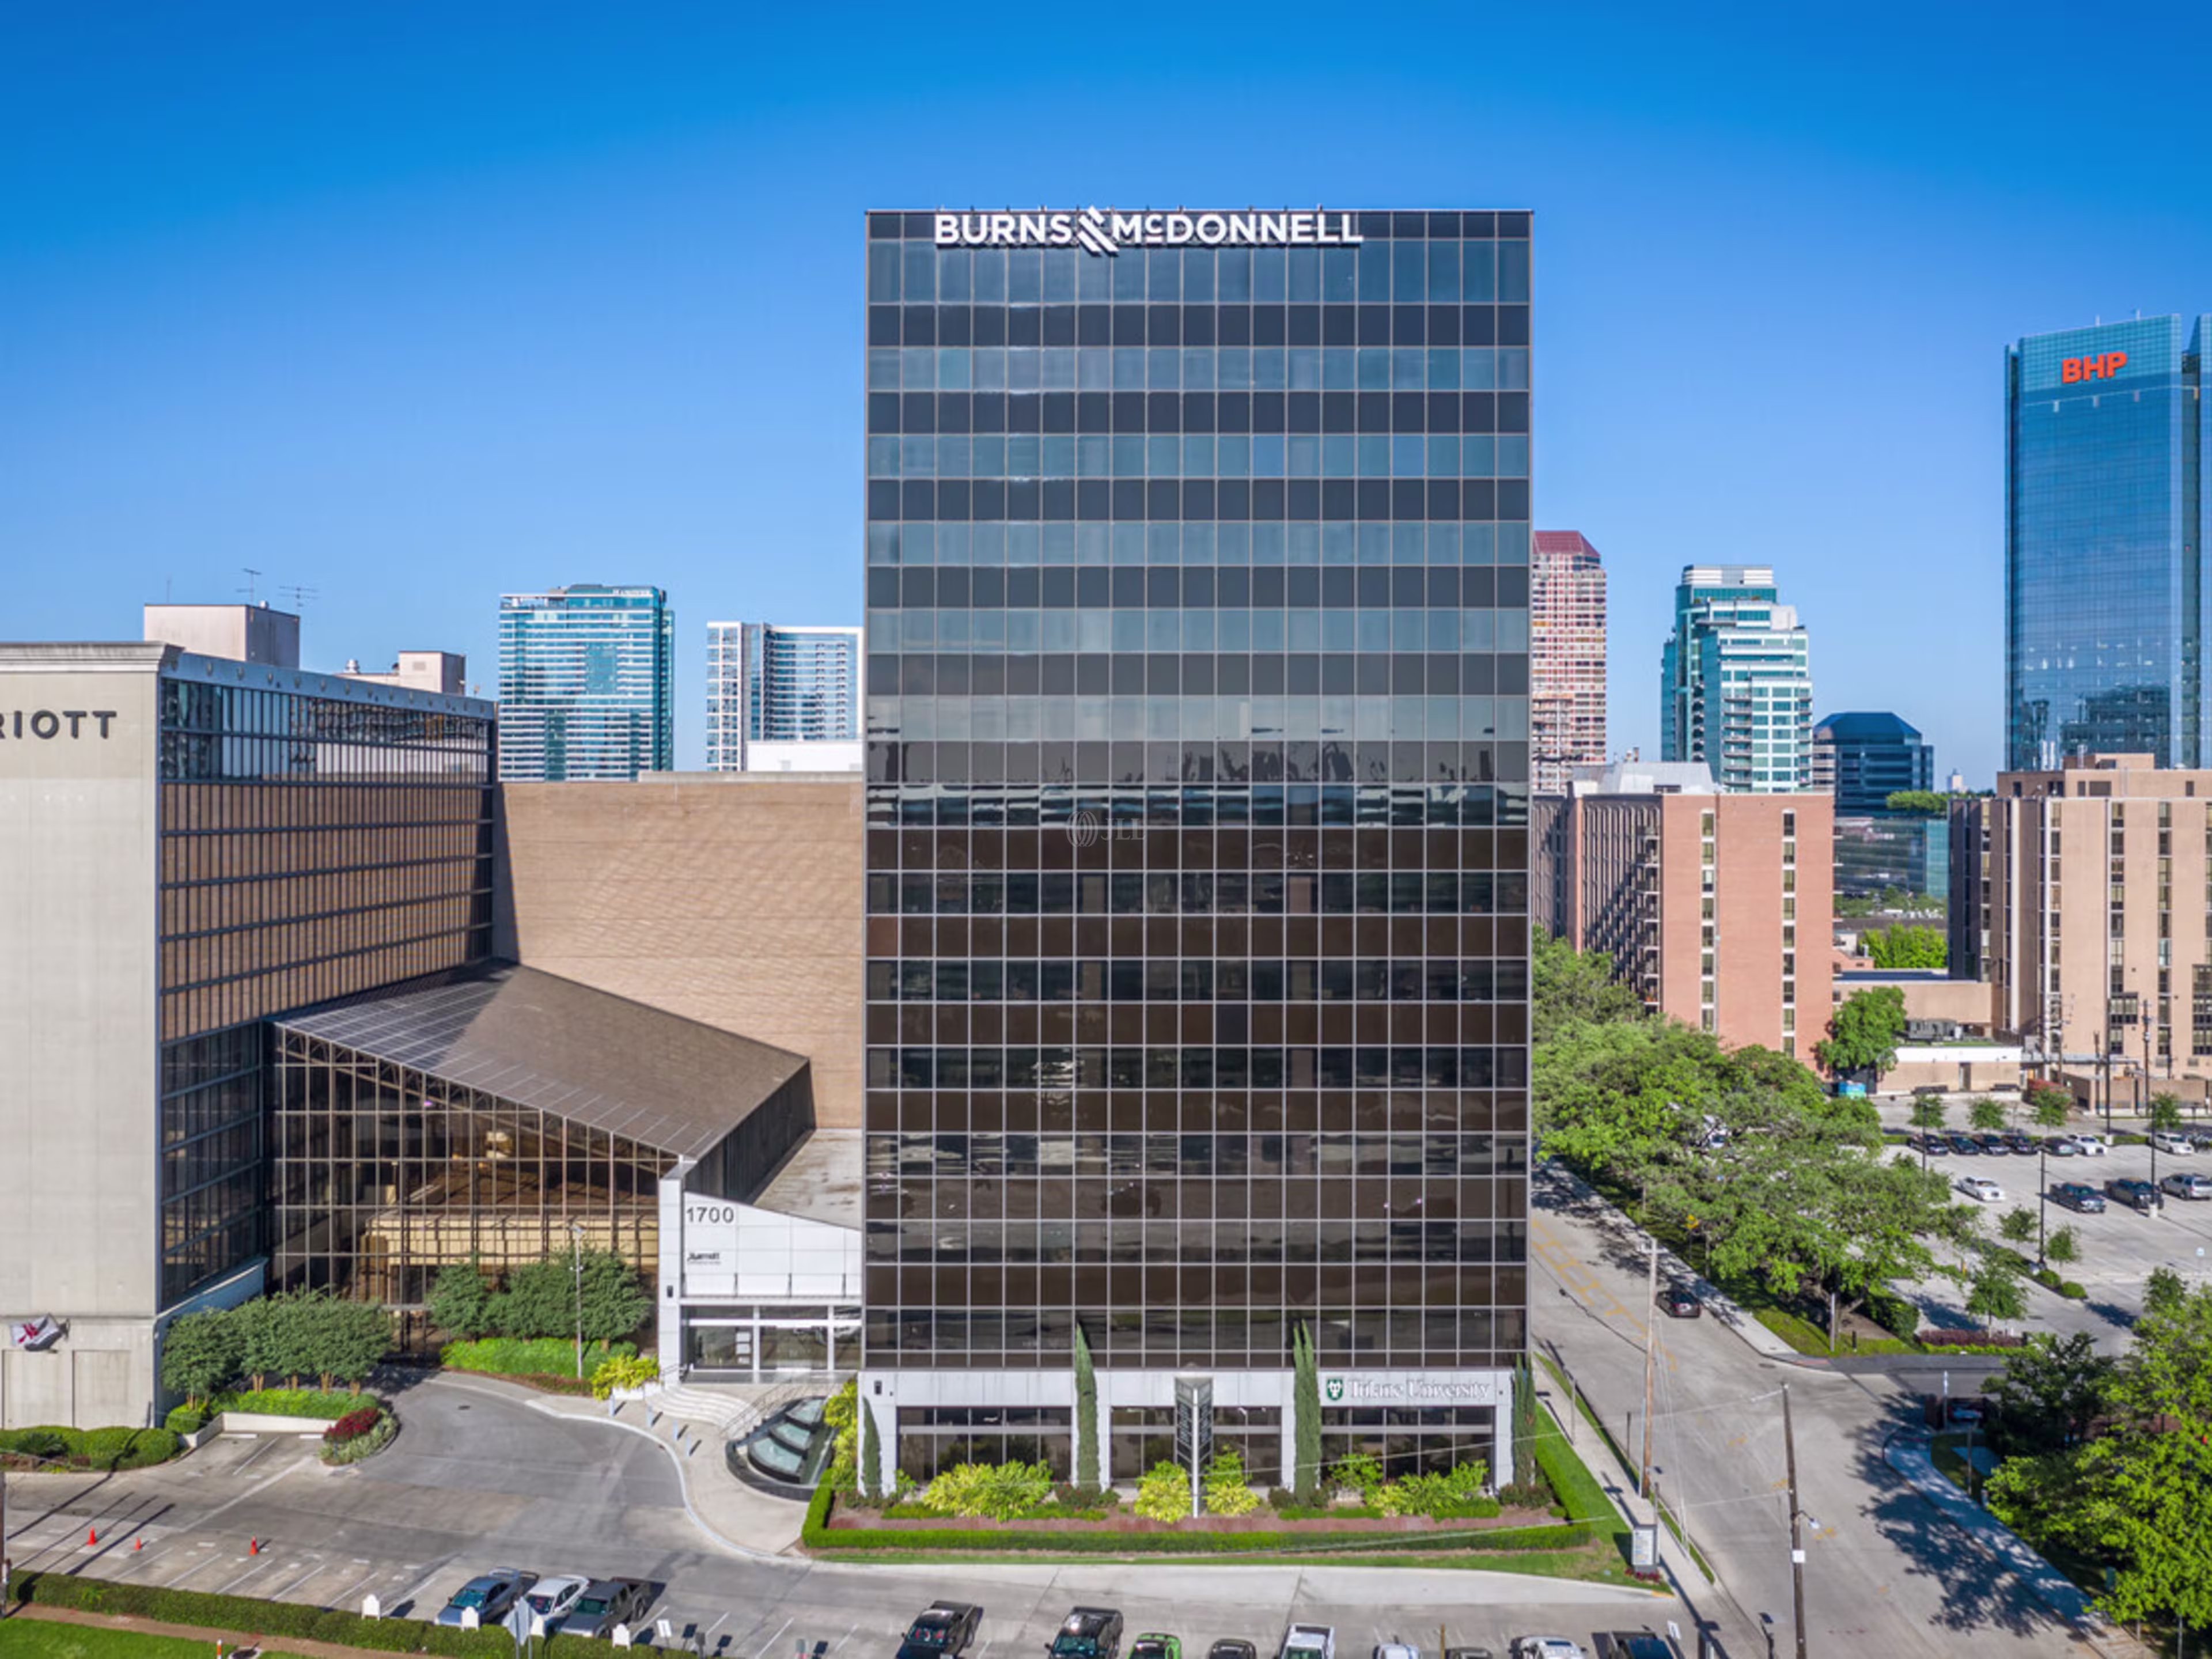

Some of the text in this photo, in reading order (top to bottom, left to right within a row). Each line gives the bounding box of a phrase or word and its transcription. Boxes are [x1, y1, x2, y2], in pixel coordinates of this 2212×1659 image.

[934, 214, 1072, 244] BURNS
[2062, 351, 2128, 384] BHP
[686, 1206, 734, 1224] 1700
[1407, 1378, 1490, 1399] University
